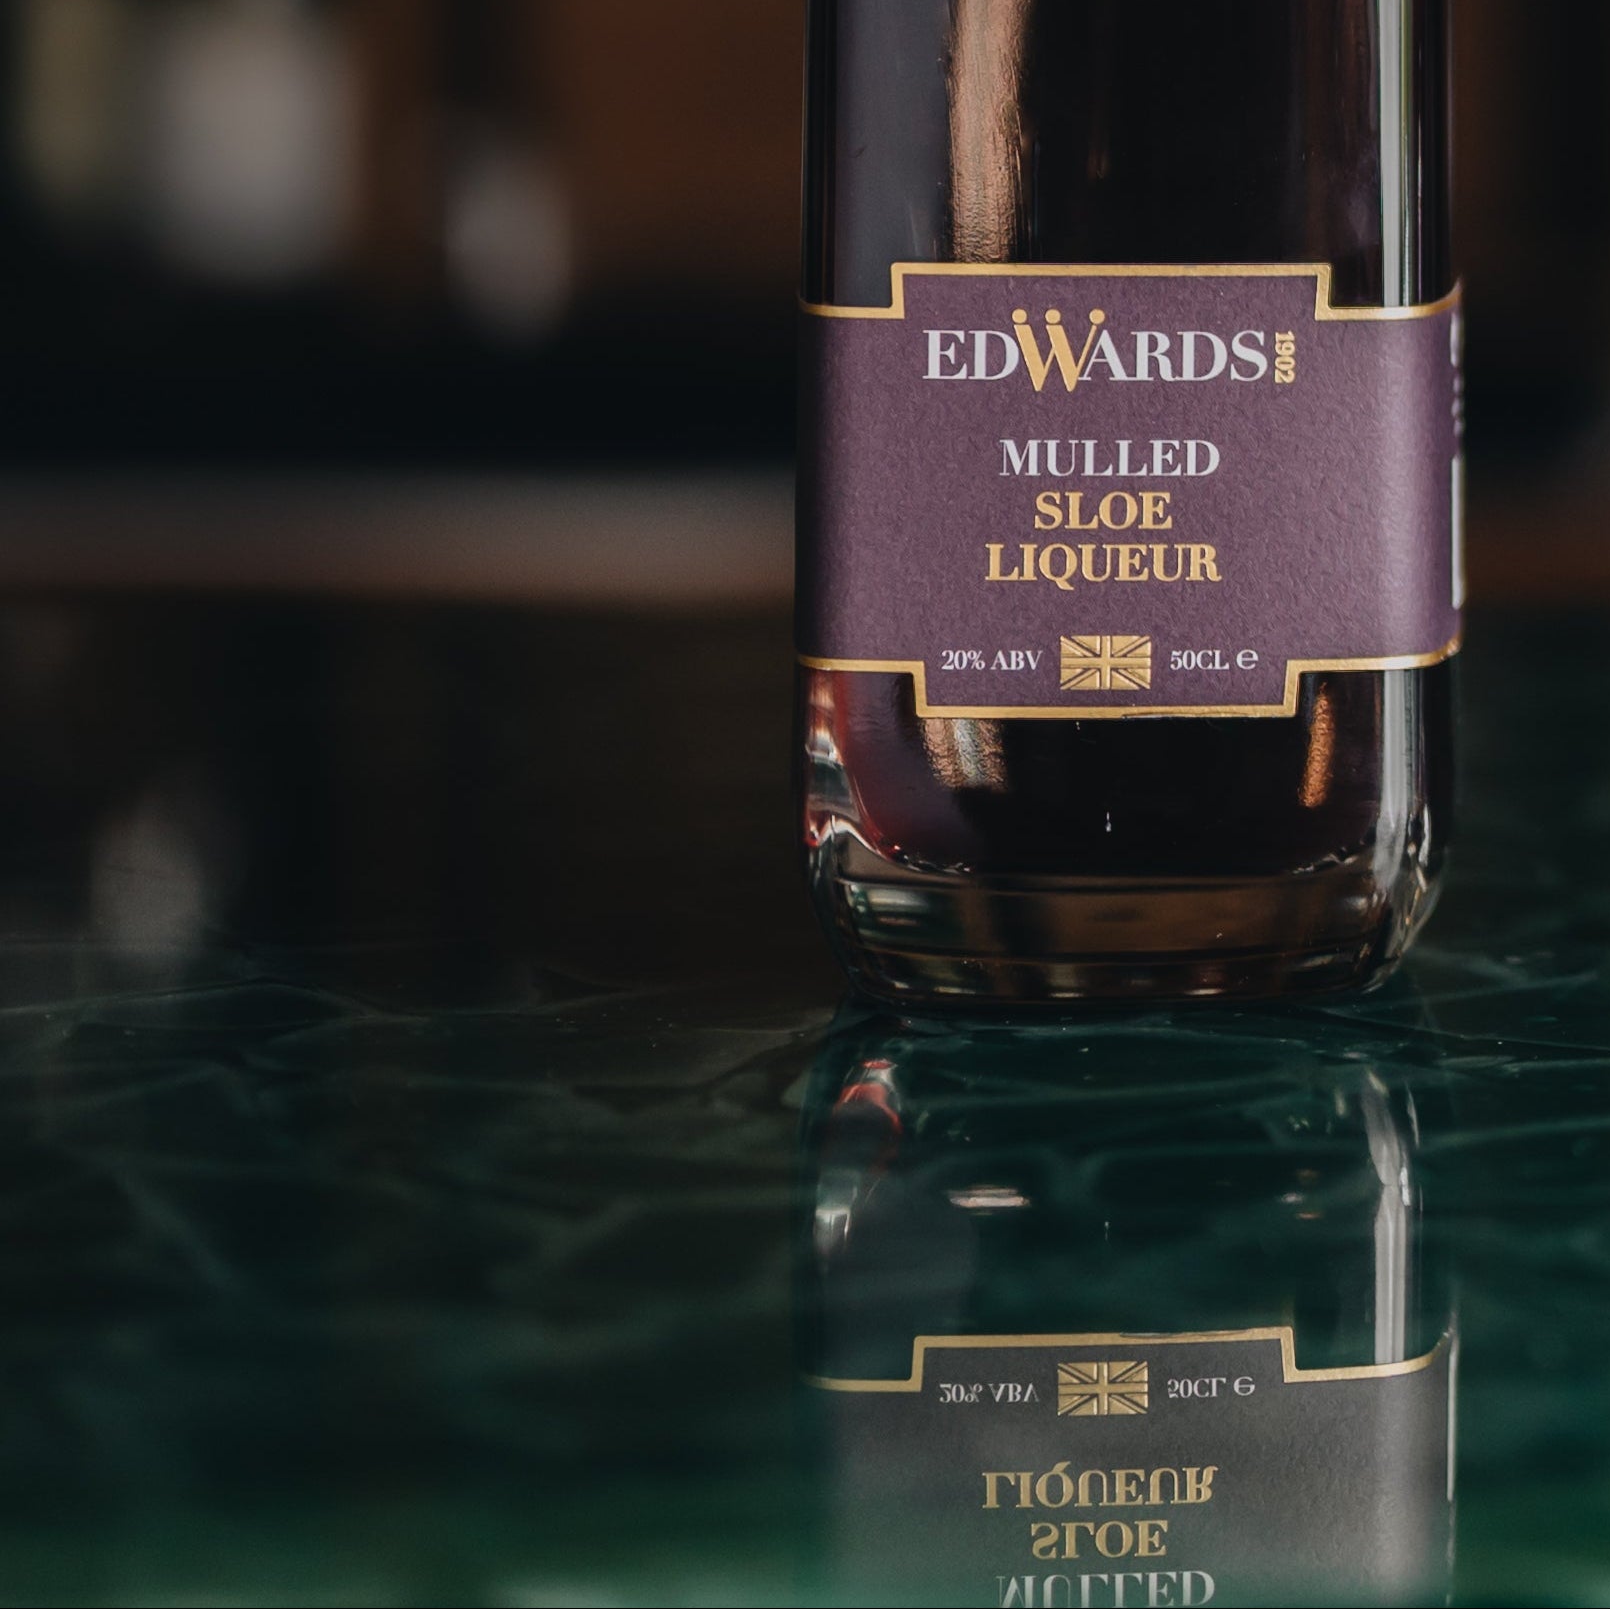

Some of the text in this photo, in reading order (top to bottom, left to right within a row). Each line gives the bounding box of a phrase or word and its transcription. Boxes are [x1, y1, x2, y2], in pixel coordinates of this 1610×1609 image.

[922, 308, 1269, 392] EDWARDS
[1274, 330, 1296, 384] 1902
[999, 439, 1221, 477] MULLED
[1034, 491, 1173, 530] SLOE
[984, 543, 1222, 591] LIQUEUR
[941, 649, 986, 671] 20%
[990, 649, 1043, 671] ABV
[1169, 649, 1229, 671] 50CL
